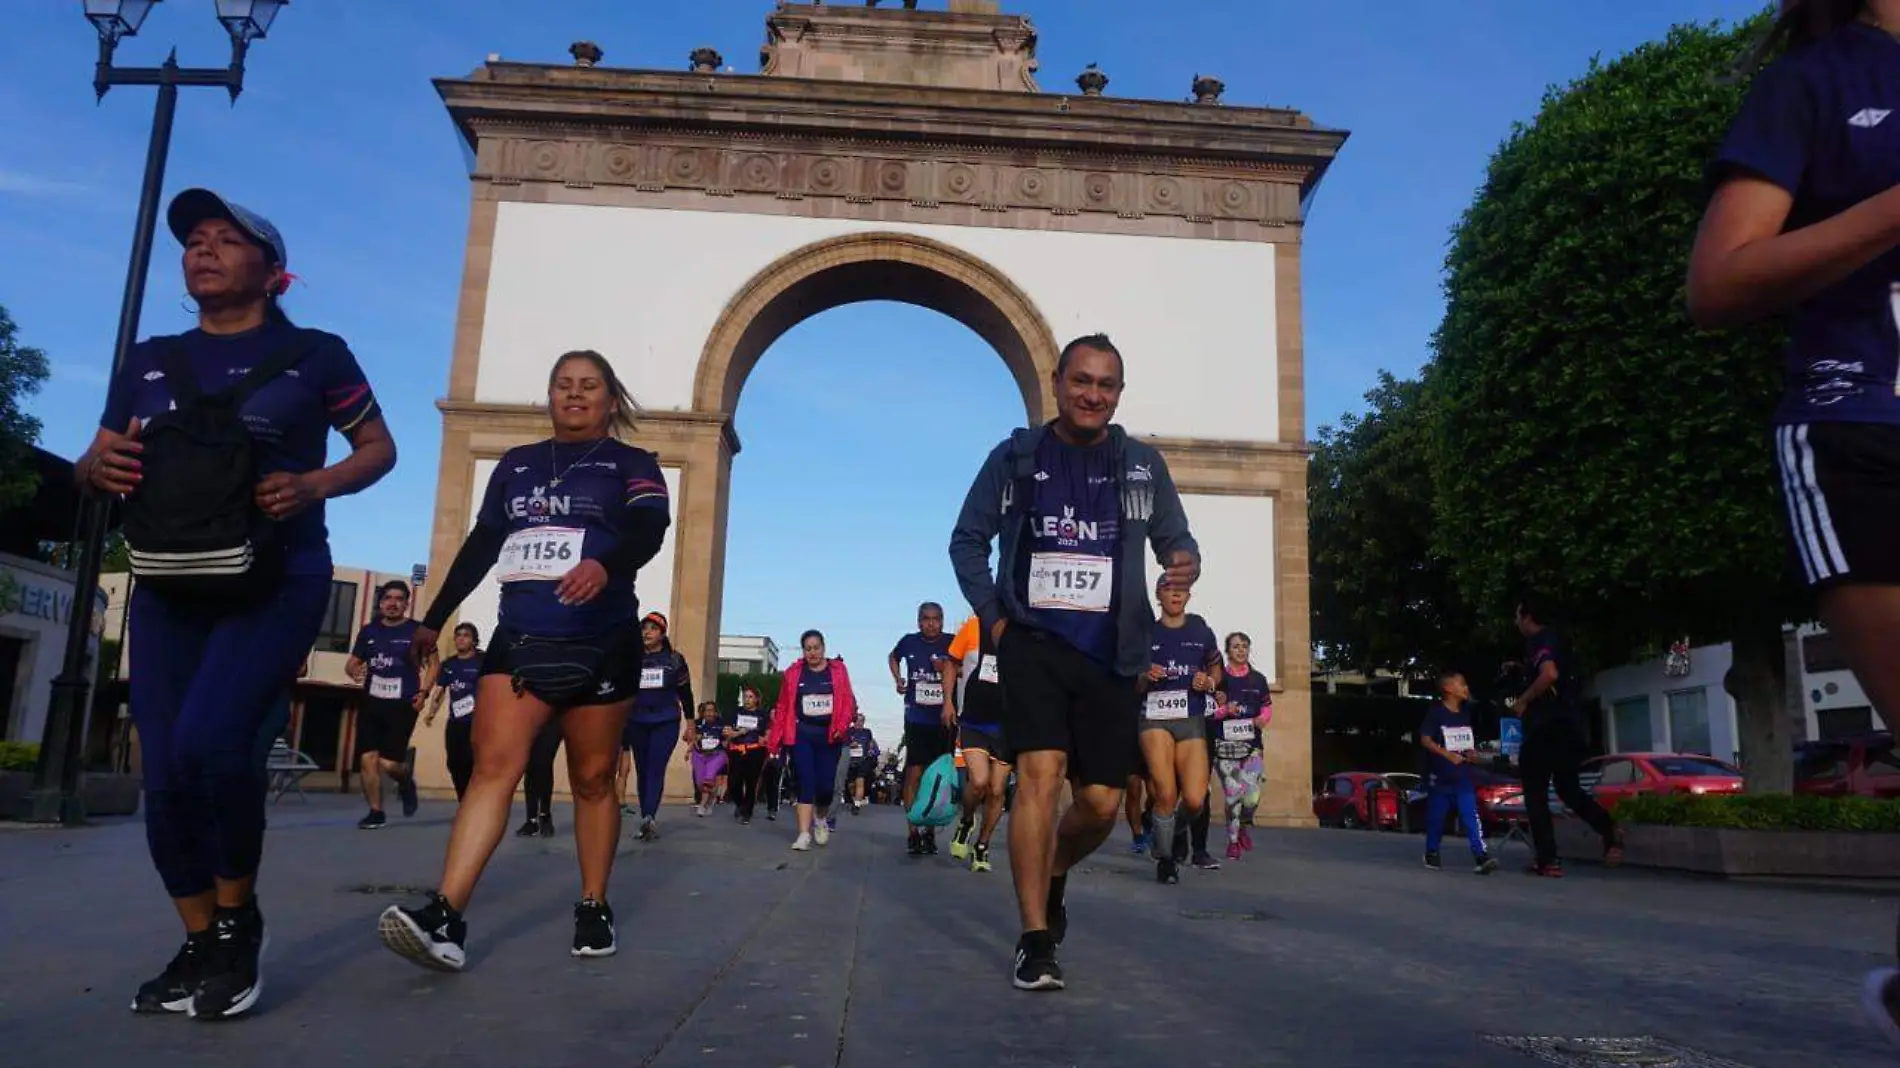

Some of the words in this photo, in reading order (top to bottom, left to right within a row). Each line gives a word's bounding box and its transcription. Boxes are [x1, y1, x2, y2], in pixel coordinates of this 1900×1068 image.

[521, 541, 572, 560] 1156
[1052, 569, 1102, 591] 1157
[1157, 698, 1188, 709] 0490
